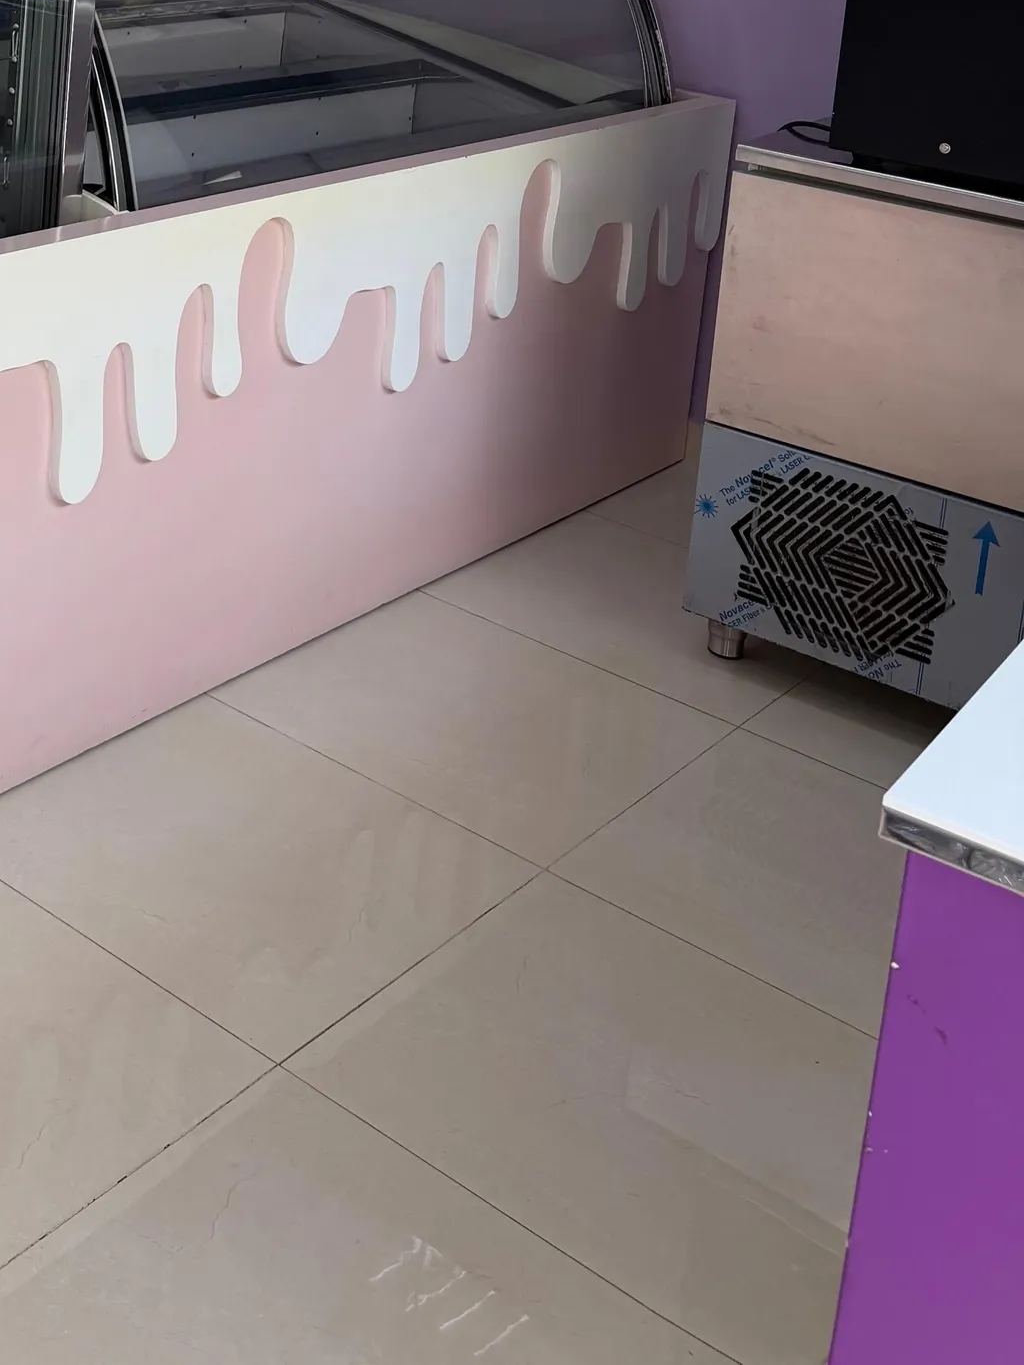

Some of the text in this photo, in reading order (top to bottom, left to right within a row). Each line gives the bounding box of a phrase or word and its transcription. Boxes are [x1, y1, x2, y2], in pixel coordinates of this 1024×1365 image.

[726, 496, 738, 506] for
[780, 457, 805, 474] LASER
[719, 485, 736, 497] The
[742, 608, 760, 622] Fiber
